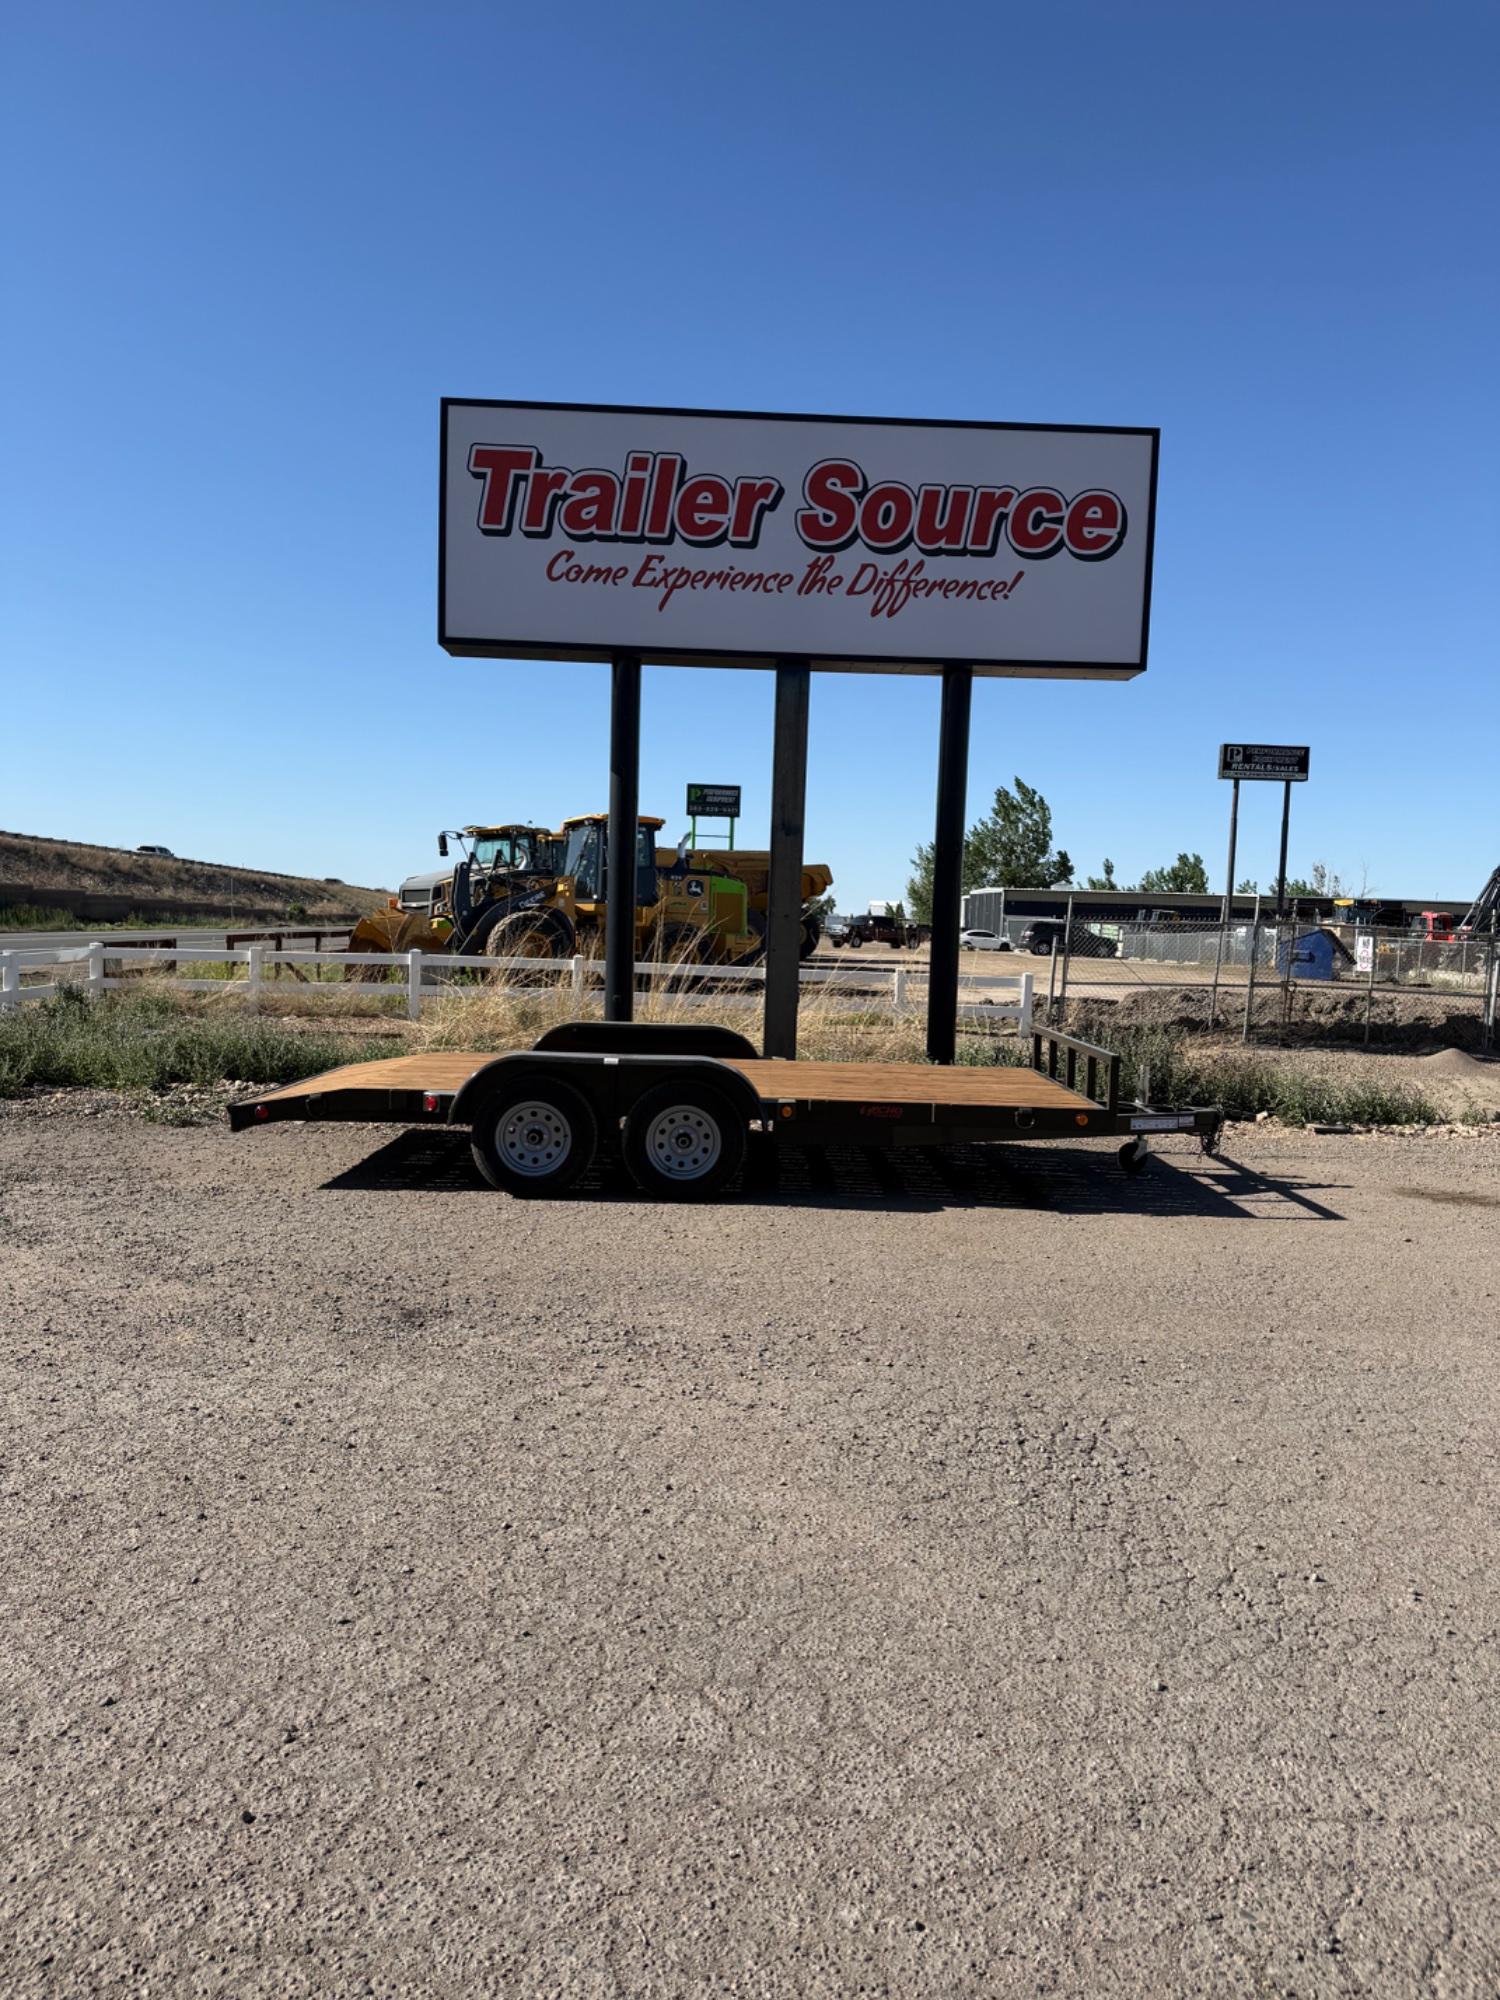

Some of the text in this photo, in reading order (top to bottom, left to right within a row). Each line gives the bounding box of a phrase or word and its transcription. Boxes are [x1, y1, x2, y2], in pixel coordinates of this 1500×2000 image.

[468, 443, 1127, 561] Trailer Source
[546, 550, 1023, 619] Come Experience the Difference!
